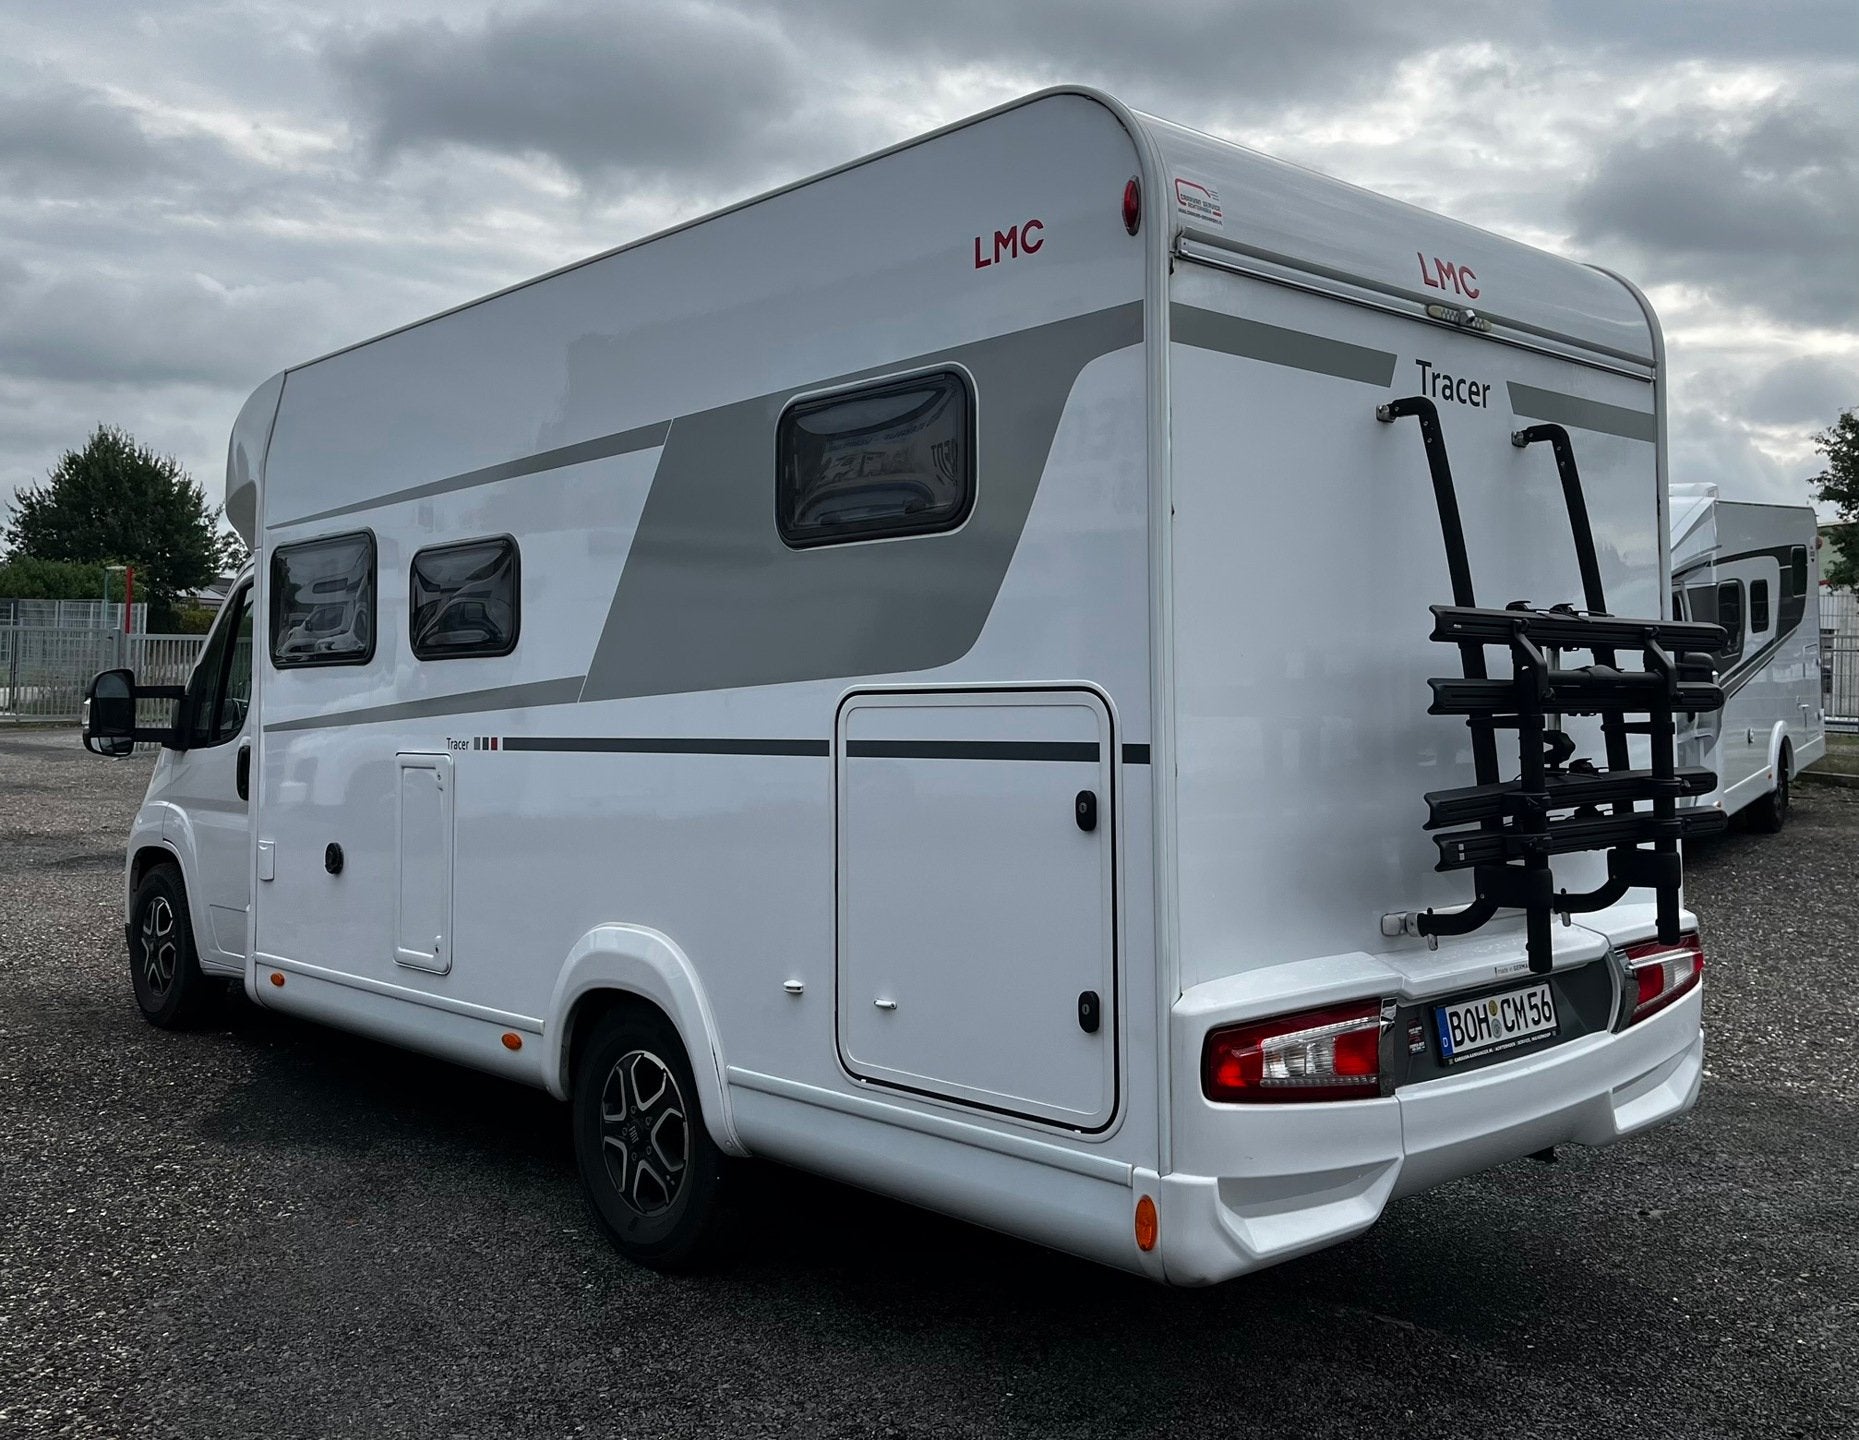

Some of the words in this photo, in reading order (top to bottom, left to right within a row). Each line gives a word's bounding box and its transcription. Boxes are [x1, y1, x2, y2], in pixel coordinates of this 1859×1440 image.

[974, 219, 1044, 269] LMC
[1417, 252, 1480, 299] LMC
[1415, 358, 1491, 409] Tracer
[446, 737, 470, 750] Tracer
[1442, 1037, 1448, 1047] D
[1448, 1004, 1492, 1048] BOH
